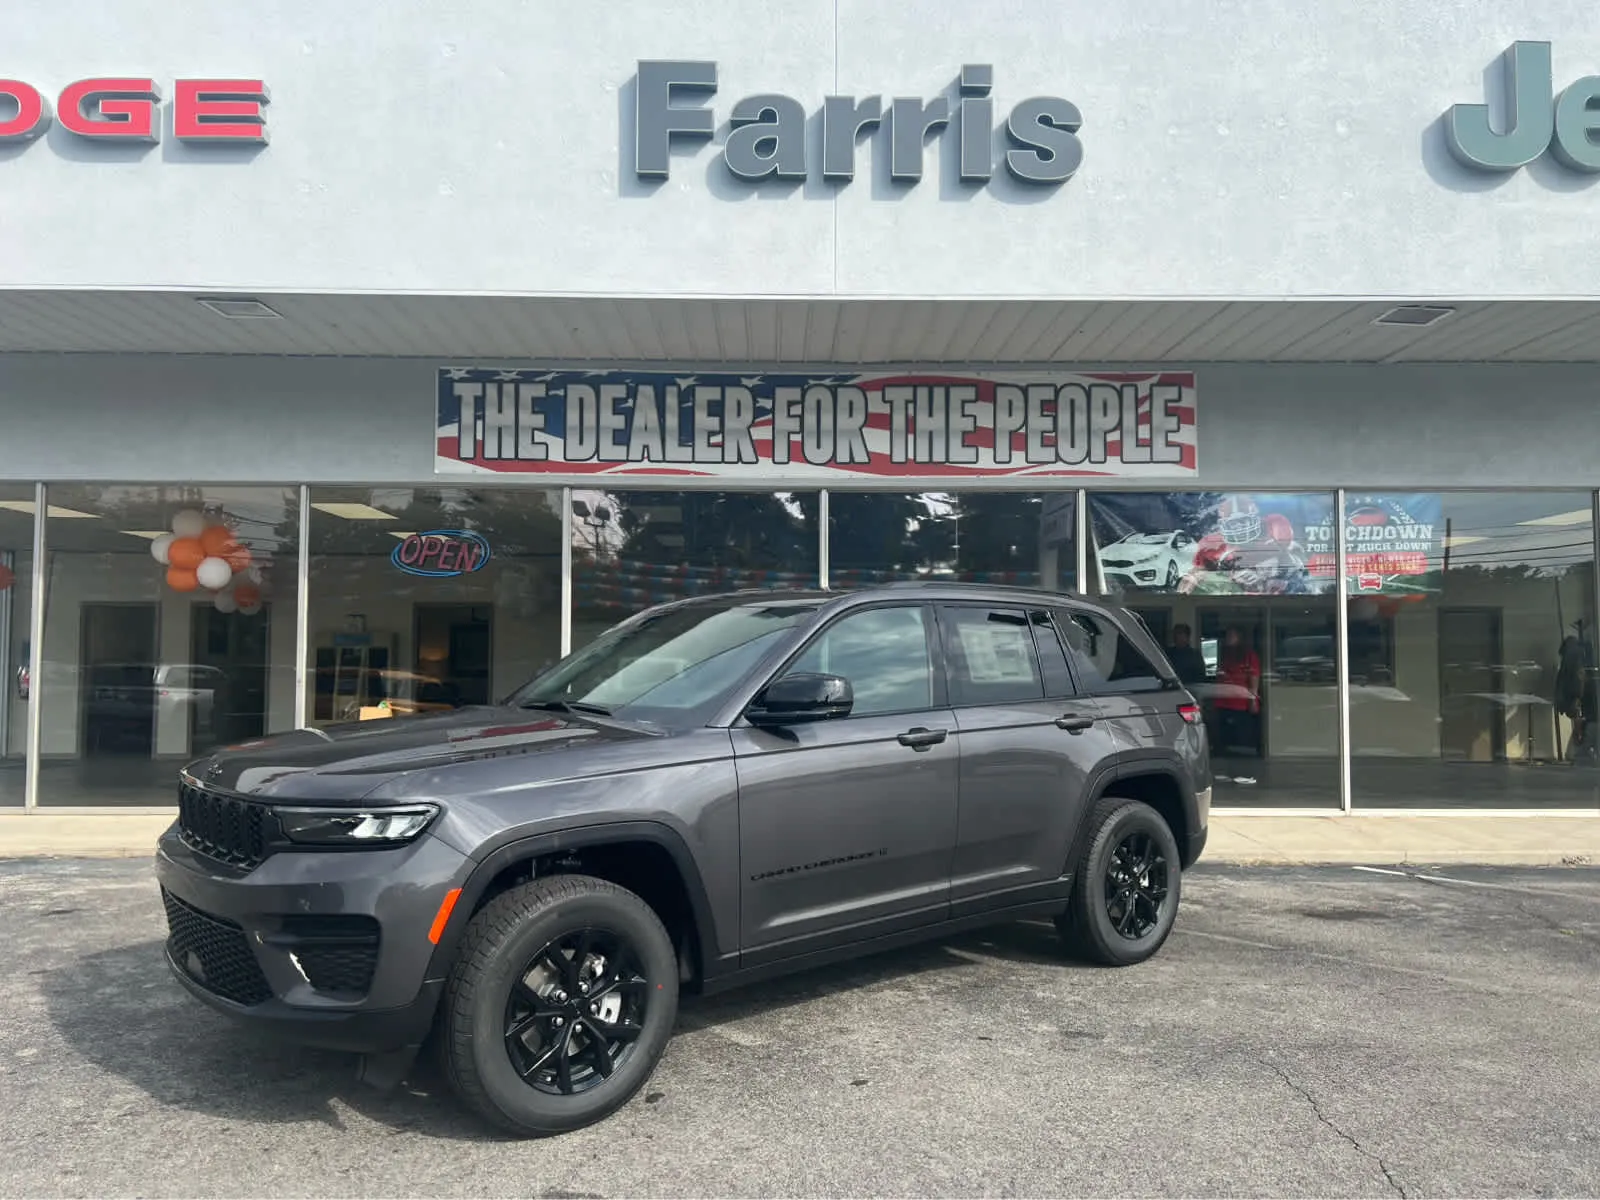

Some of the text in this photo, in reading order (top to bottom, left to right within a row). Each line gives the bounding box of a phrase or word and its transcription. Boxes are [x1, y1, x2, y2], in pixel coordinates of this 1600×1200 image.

[636, 60, 1084, 184] Farris
[453, 382, 1182, 465] THE DEALER FOR THE PEOPLE
[1305, 525, 1434, 541] TOCHDOWN
[1306, 543, 1328, 553] FOR
[1357, 542, 1391, 553] MUCH
[400, 534, 480, 573] OPEN
